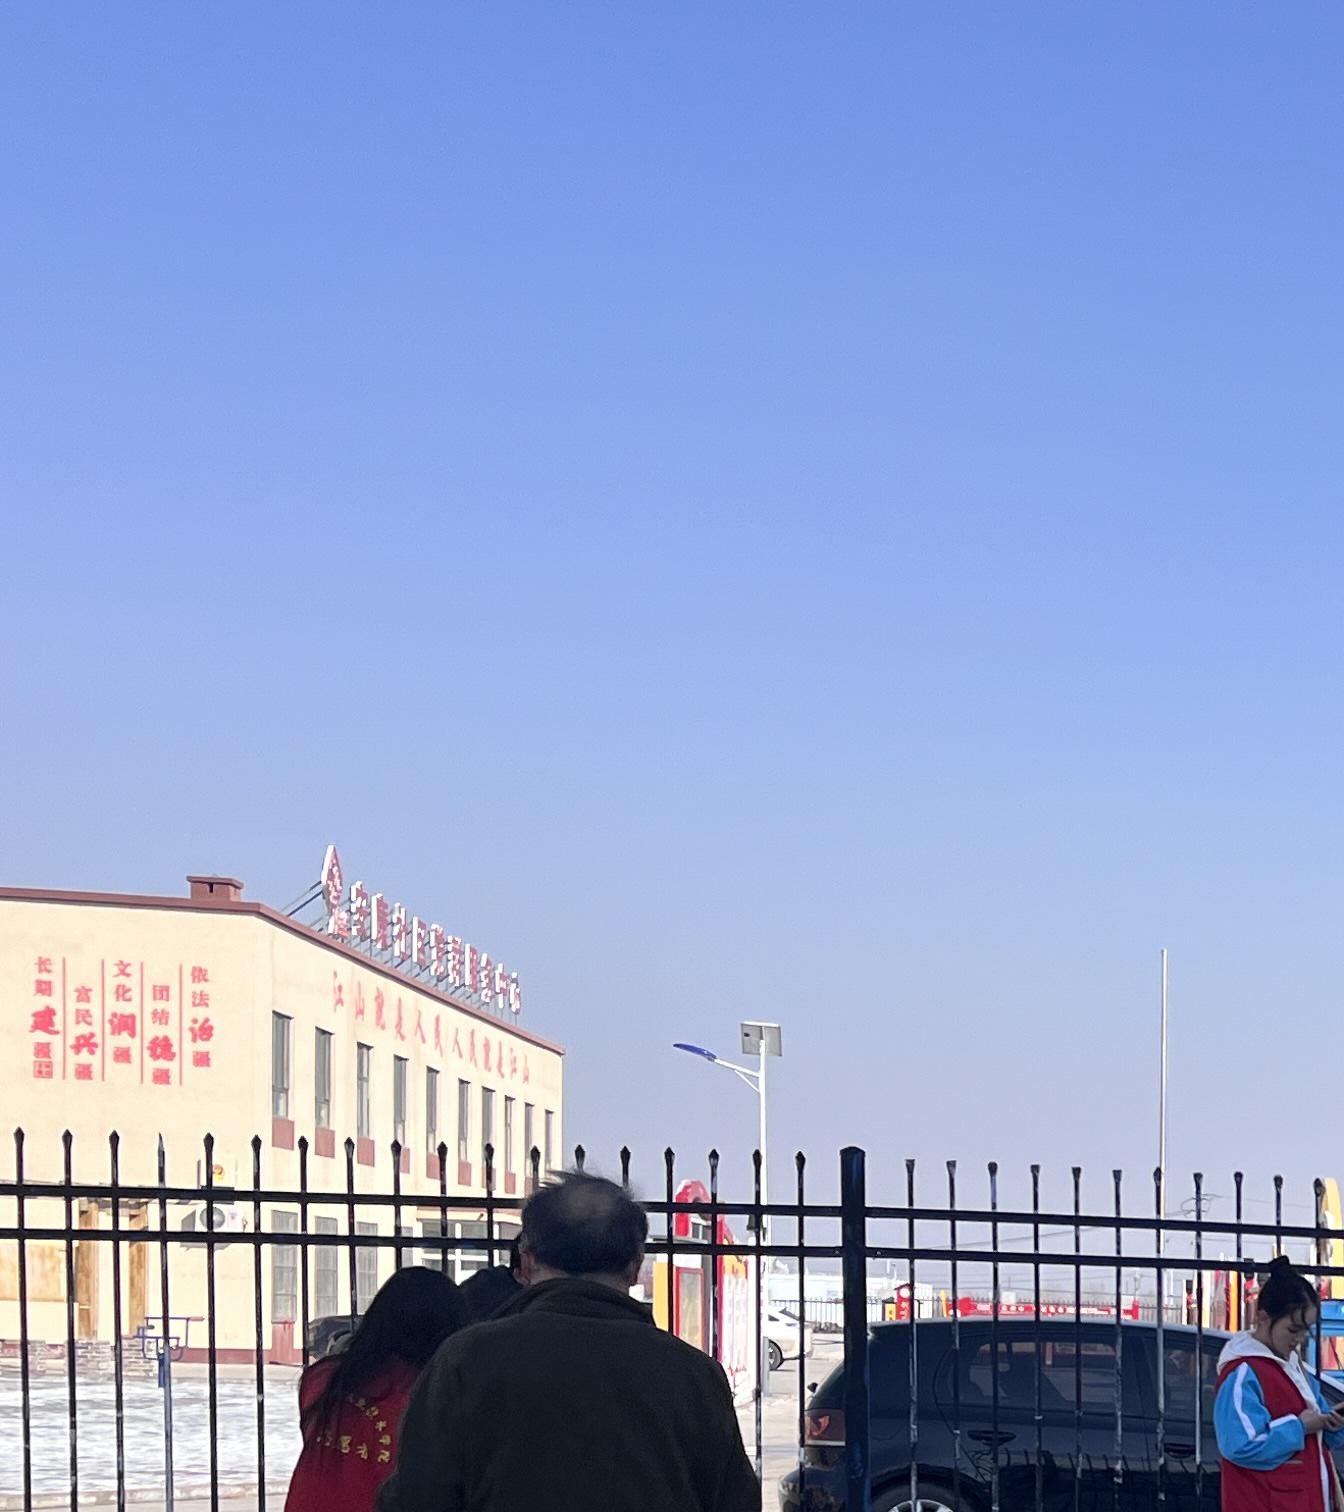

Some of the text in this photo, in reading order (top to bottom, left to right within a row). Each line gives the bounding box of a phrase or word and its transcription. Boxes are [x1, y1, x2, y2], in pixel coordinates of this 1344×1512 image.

[29, 956, 60, 1059] 长期建疆
[69, 985, 99, 1080] 富民兴疆
[108, 960, 136, 1064] 文化润疆
[188, 966, 214, 1068] 依法治疆
